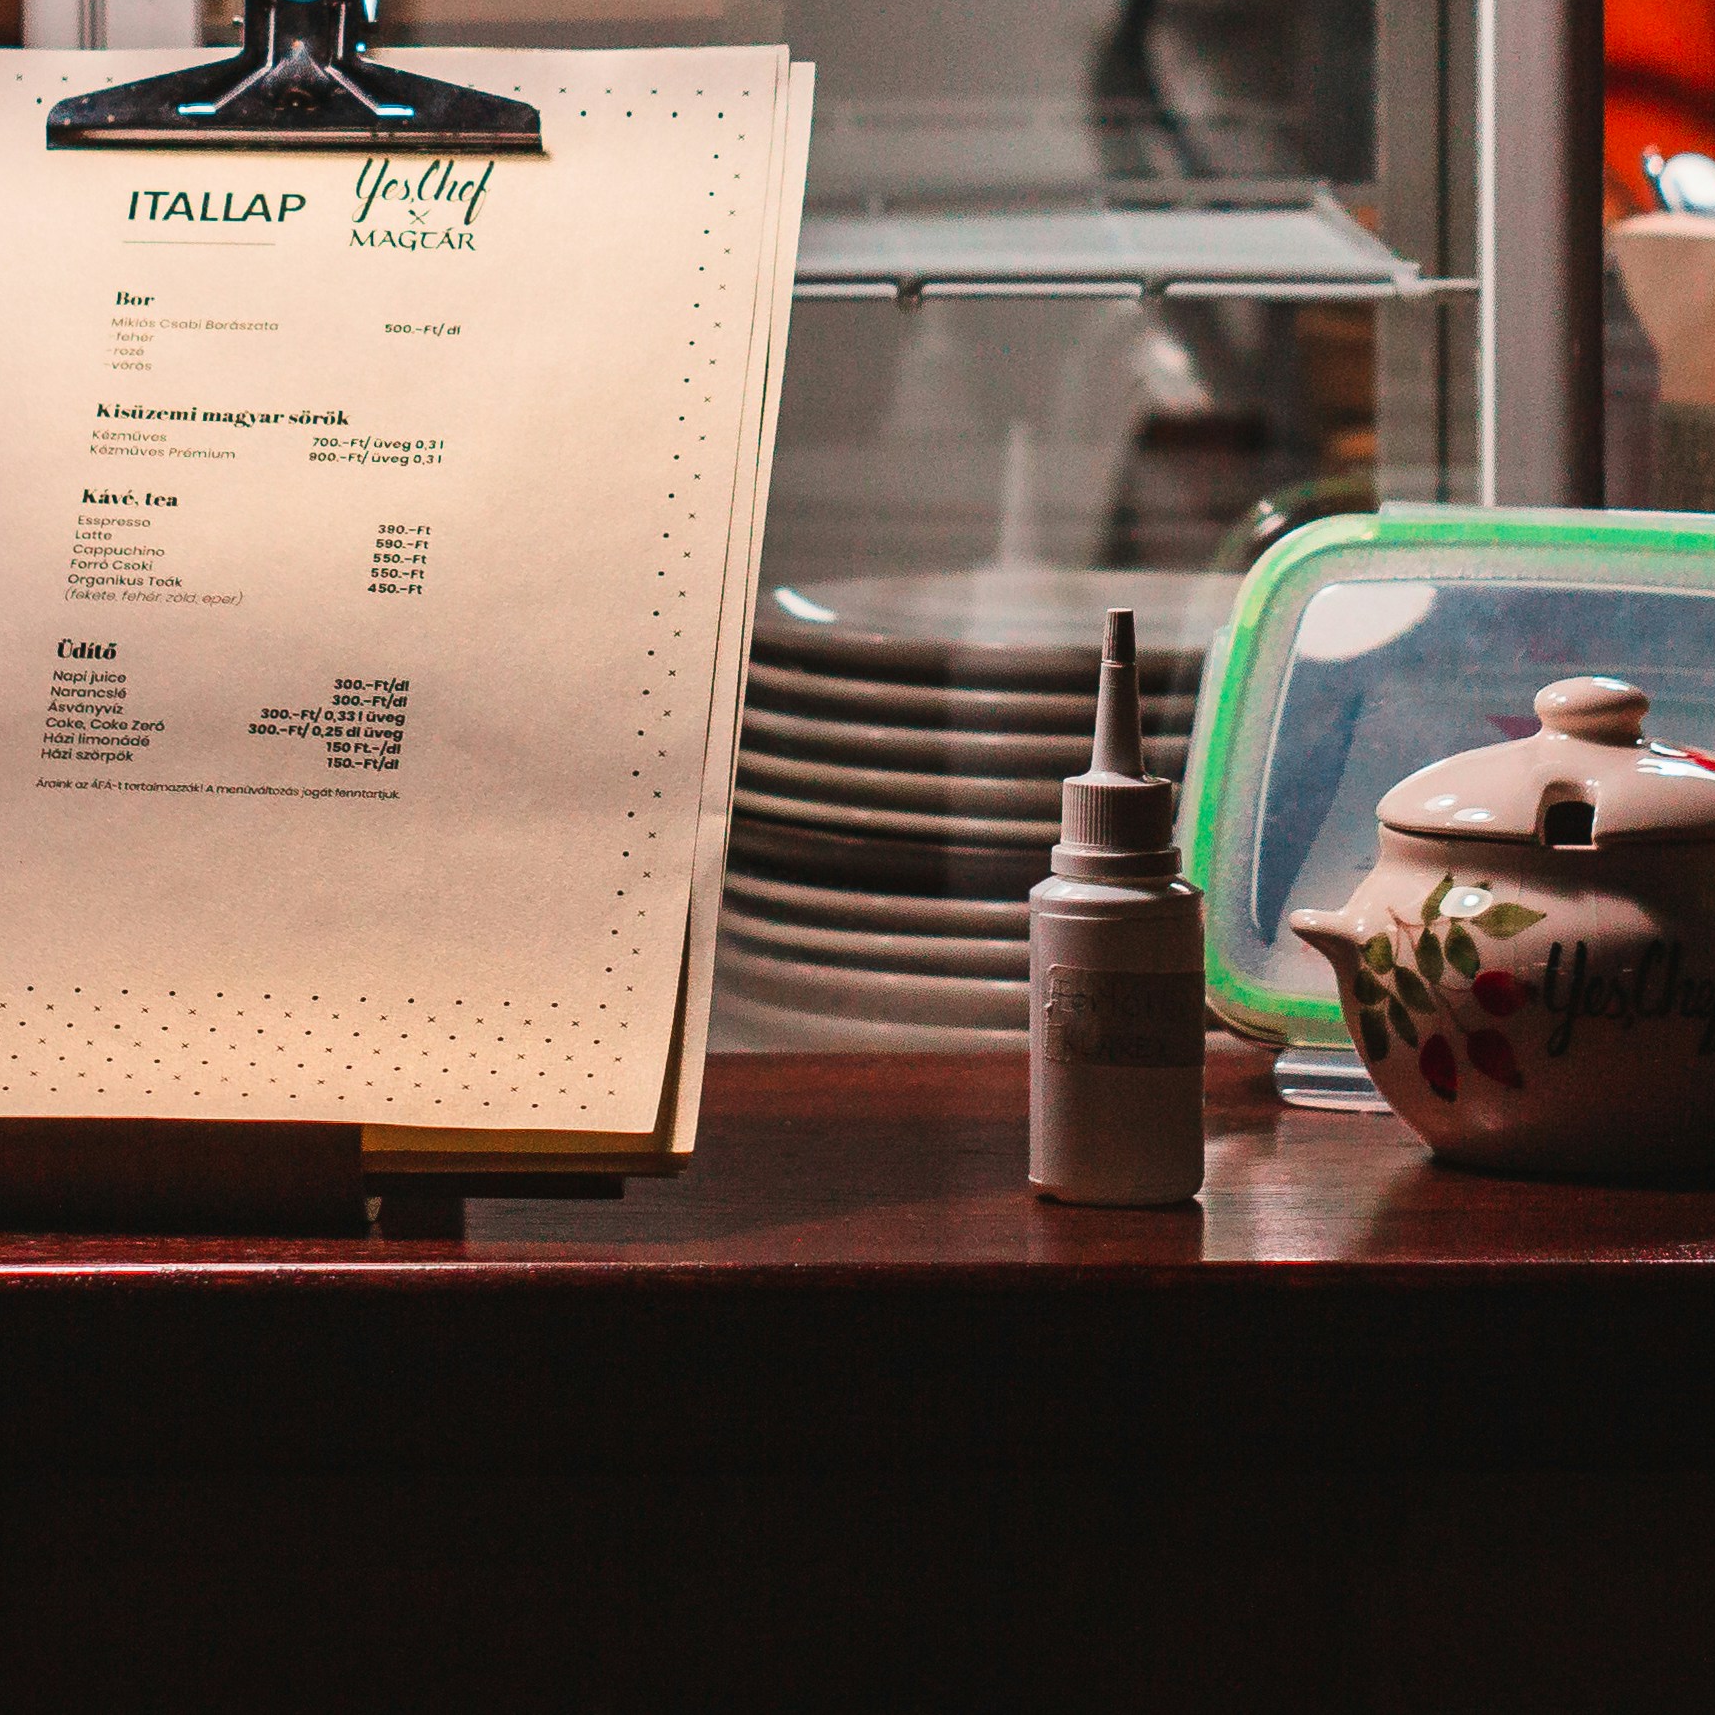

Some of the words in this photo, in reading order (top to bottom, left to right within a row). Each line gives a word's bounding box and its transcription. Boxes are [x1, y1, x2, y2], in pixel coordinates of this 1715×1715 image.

[128, 190, 307, 223] ITALLAP
[349, 227, 476, 252] MAGTÁR
[115, 291, 155, 307] Bor
[110, 317, 156, 329] Miklós
[158, 318, 203, 330] Csabi
[204, 319, 280, 332] Borászata
[96, 403, 198, 422] Kisüzemi
[202, 411, 285, 429] magyar
[288, 409, 349, 426] sörök
[168, 447, 237, 460] Prémium
[373, 440, 412, 453] üveg
[371, 455, 410, 467] üveg
[81, 488, 139, 506] Kávé,
[144, 492, 178, 507] tea
[77, 514, 152, 529] Esspresso
[74, 530, 113, 541] Latte
[377, 524, 431, 536] 390.-Ft
[72, 543, 166, 558] Cappuchino
[375, 538, 429, 550] 590.-Ft
[69, 558, 110, 570] Forró
[111, 559, 154, 572] Csoki
[372, 552, 427, 565] 550.-Ft
[67, 573, 144, 589] Organikus
[148, 575, 183, 588] Teák
[370, 567, 425, 580] 550.-Ft
[366, 582, 423, 596] 450.-Ft
[56, 638, 118, 660] Üdítő
[52, 669, 88, 685] Napi
[88, 670, 127, 686] juice
[49, 685, 128, 700] Narancslé
[333, 677, 410, 695] 300.-Ft/dl
[46, 699, 124, 718] Ásványvíz
[331, 692, 409, 710] 300.-Ft/dl
[89, 718, 129, 731] Coke
[130, 719, 166, 732] Zeró
[323, 709, 356, 724] 0,33
[365, 711, 406, 728] üveg
[42, 732, 76, 745] Házi
[77, 732, 151, 748] limonádé
[311, 725, 344, 739] 0,25
[345, 725, 362, 738] dl
[363, 726, 404, 743] üveg
[325, 741, 352, 754] 150
[40, 747, 73, 761] Házi
[75, 749, 134, 765] szörpök
[326, 756, 400, 773] 150.-Ft/dl
[34, 776, 74, 789] Áraink
[74, 780, 90, 790] az
[204, 784, 215, 794] A
[300, 787, 335, 800] jogát
